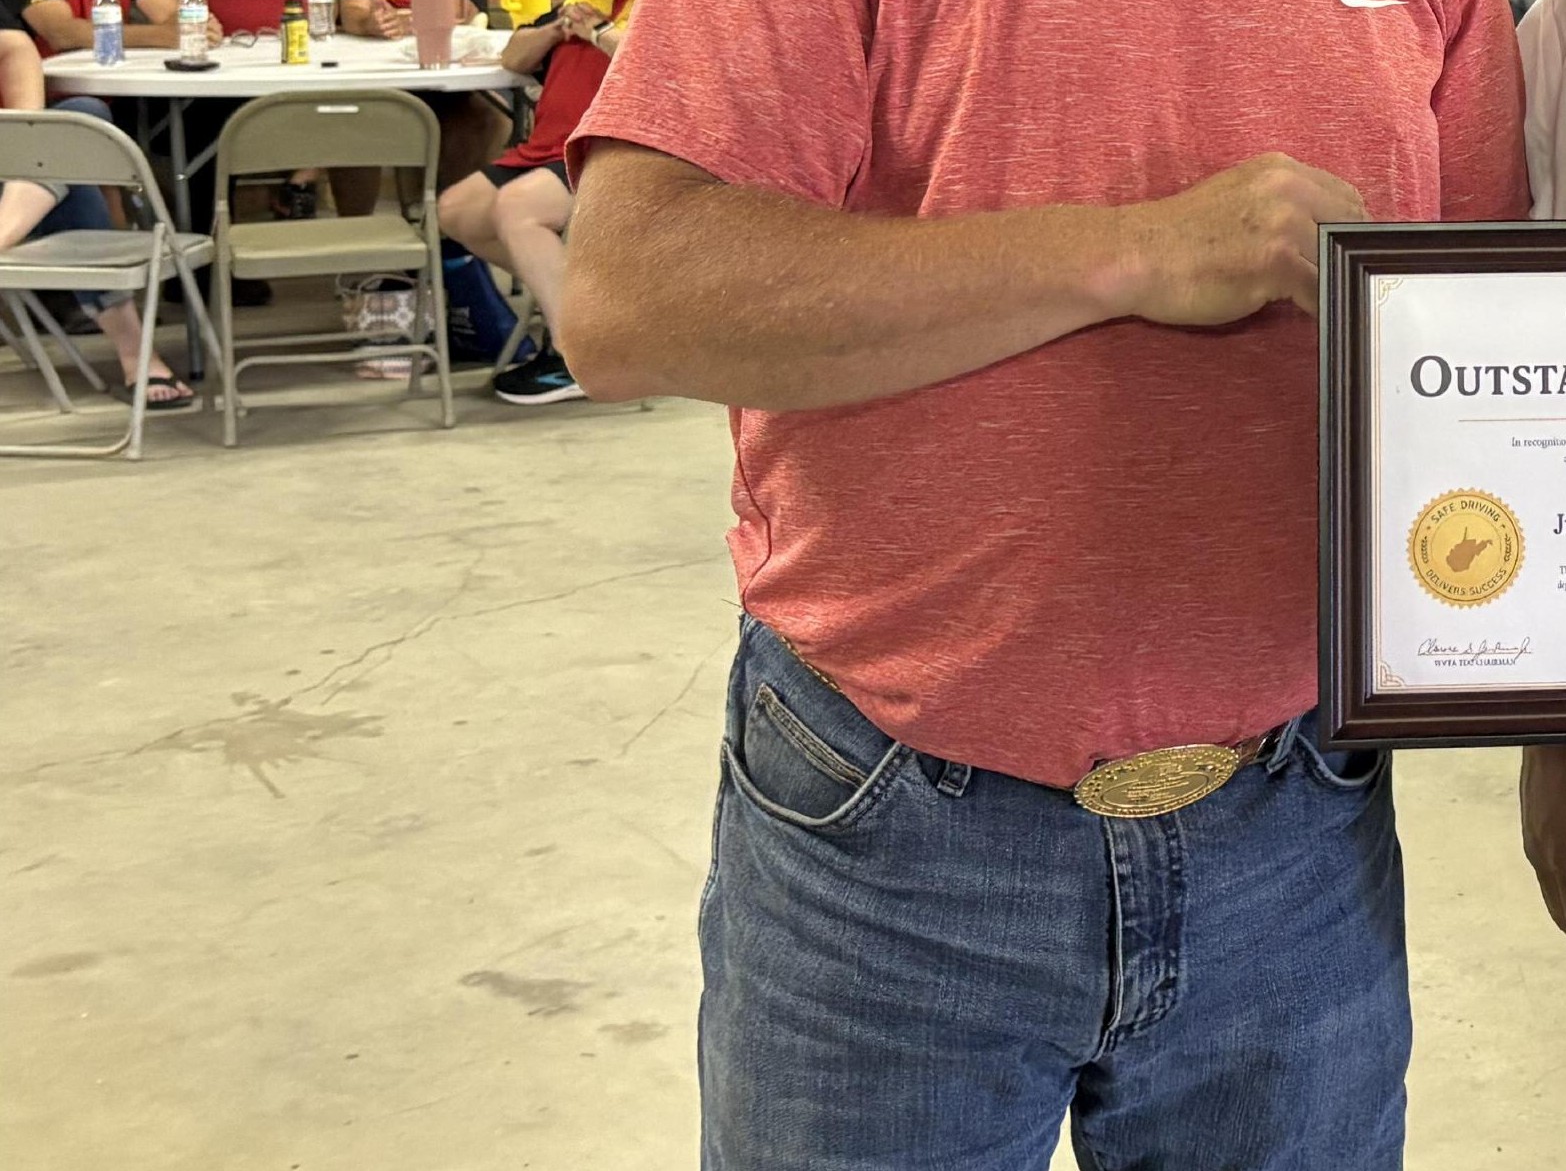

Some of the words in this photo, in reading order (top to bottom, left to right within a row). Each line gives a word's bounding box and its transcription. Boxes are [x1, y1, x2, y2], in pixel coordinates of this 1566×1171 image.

[1512, 436, 1521, 448] In
[1430, 502, 1457, 523] SAFE
[1460, 500, 1501, 523] DRIVING
[1425, 568, 1466, 596] DELIVERS
[1469, 568, 1507, 596] SUCCESS
